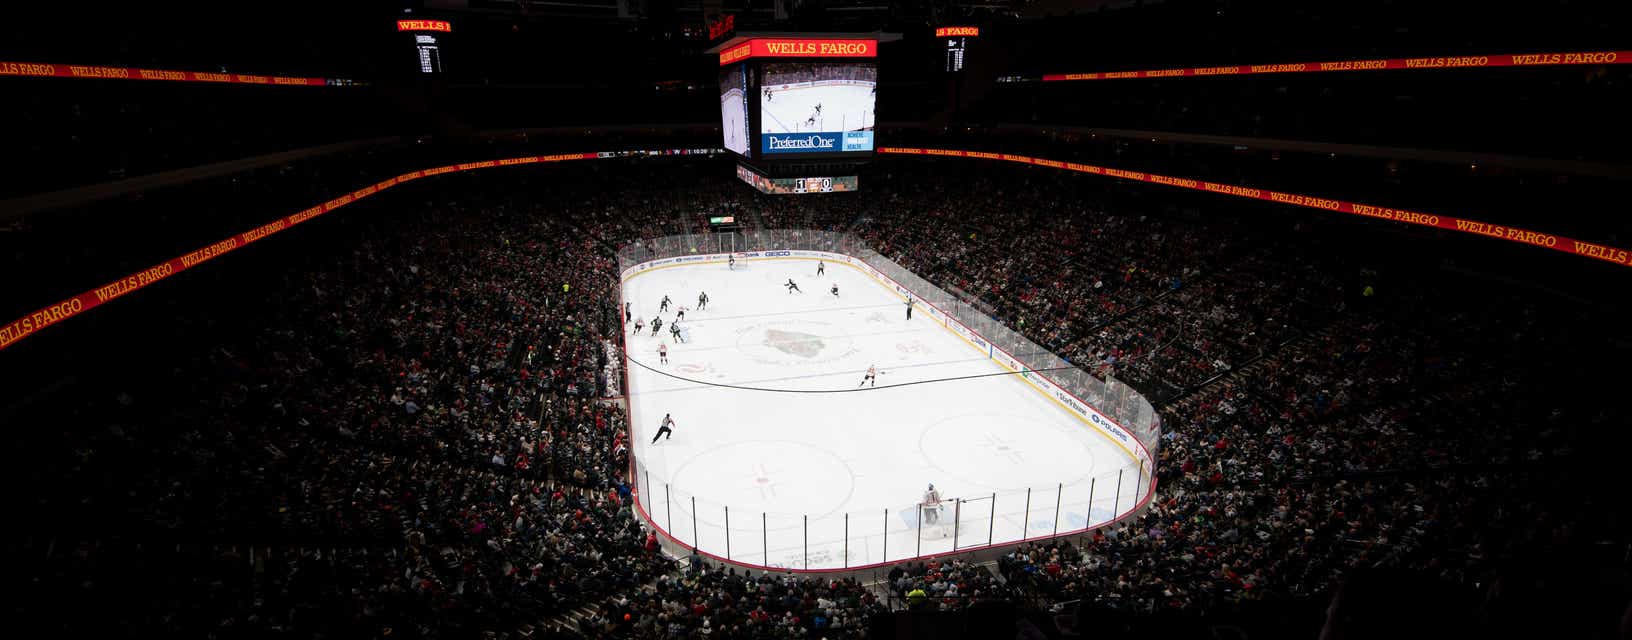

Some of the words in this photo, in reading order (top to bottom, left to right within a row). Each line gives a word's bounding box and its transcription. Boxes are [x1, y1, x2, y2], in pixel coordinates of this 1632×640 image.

[400, 22, 443, 30] WELLS
[767, 43, 816, 54] WELLS
[821, 43, 867, 54] FARGO
[1406, 58, 1444, 67] WELLS
[1446, 57, 1488, 66] FARGO
[1512, 54, 1560, 64] WELLS
[1564, 52, 1616, 63] FARGO
[17, 64, 54, 75] FARGO
[1276, 64, 1305, 72] FARGO
[1320, 62, 1351, 70] WELLS
[1353, 60, 1386, 69] FARGO
[70, 66, 101, 77] WELLS
[102, 68, 128, 78] FARGO
[140, 70, 164, 79] WELLS
[164, 71, 185, 80] FARGO
[1105, 169, 1124, 177] WELLS
[1123, 171, 1144, 180] FARGO
[798, 180, 804, 188] 1
[823, 179, 830, 187] 0
[1151, 175, 1172, 184] WELLS
[1173, 178, 1196, 188] FARGO
[1205, 183, 1231, 193] WELLS
[1232, 187, 1260, 197] FARGO
[1271, 192, 1303, 204] WELLS
[1304, 197, 1339, 210] FARGO
[289, 211, 307, 224] WELLS
[306, 206, 322, 219] FARGO
[1352, 204, 1392, 218] WELLS
[1394, 211, 1438, 225] FARGO
[243, 227, 265, 243] WELLS
[264, 220, 284, 236] FARGO
[1456, 220, 1504, 237] WELLS
[1506, 229, 1556, 246] FARGO
[181, 248, 212, 268] WELLS
[211, 238, 236, 256] FARGO
[1575, 241, 1627, 263] WELLS
[95, 277, 138, 301] WELLS
[138, 263, 172, 286] FARGO
[33, 299, 81, 328] FARGO
